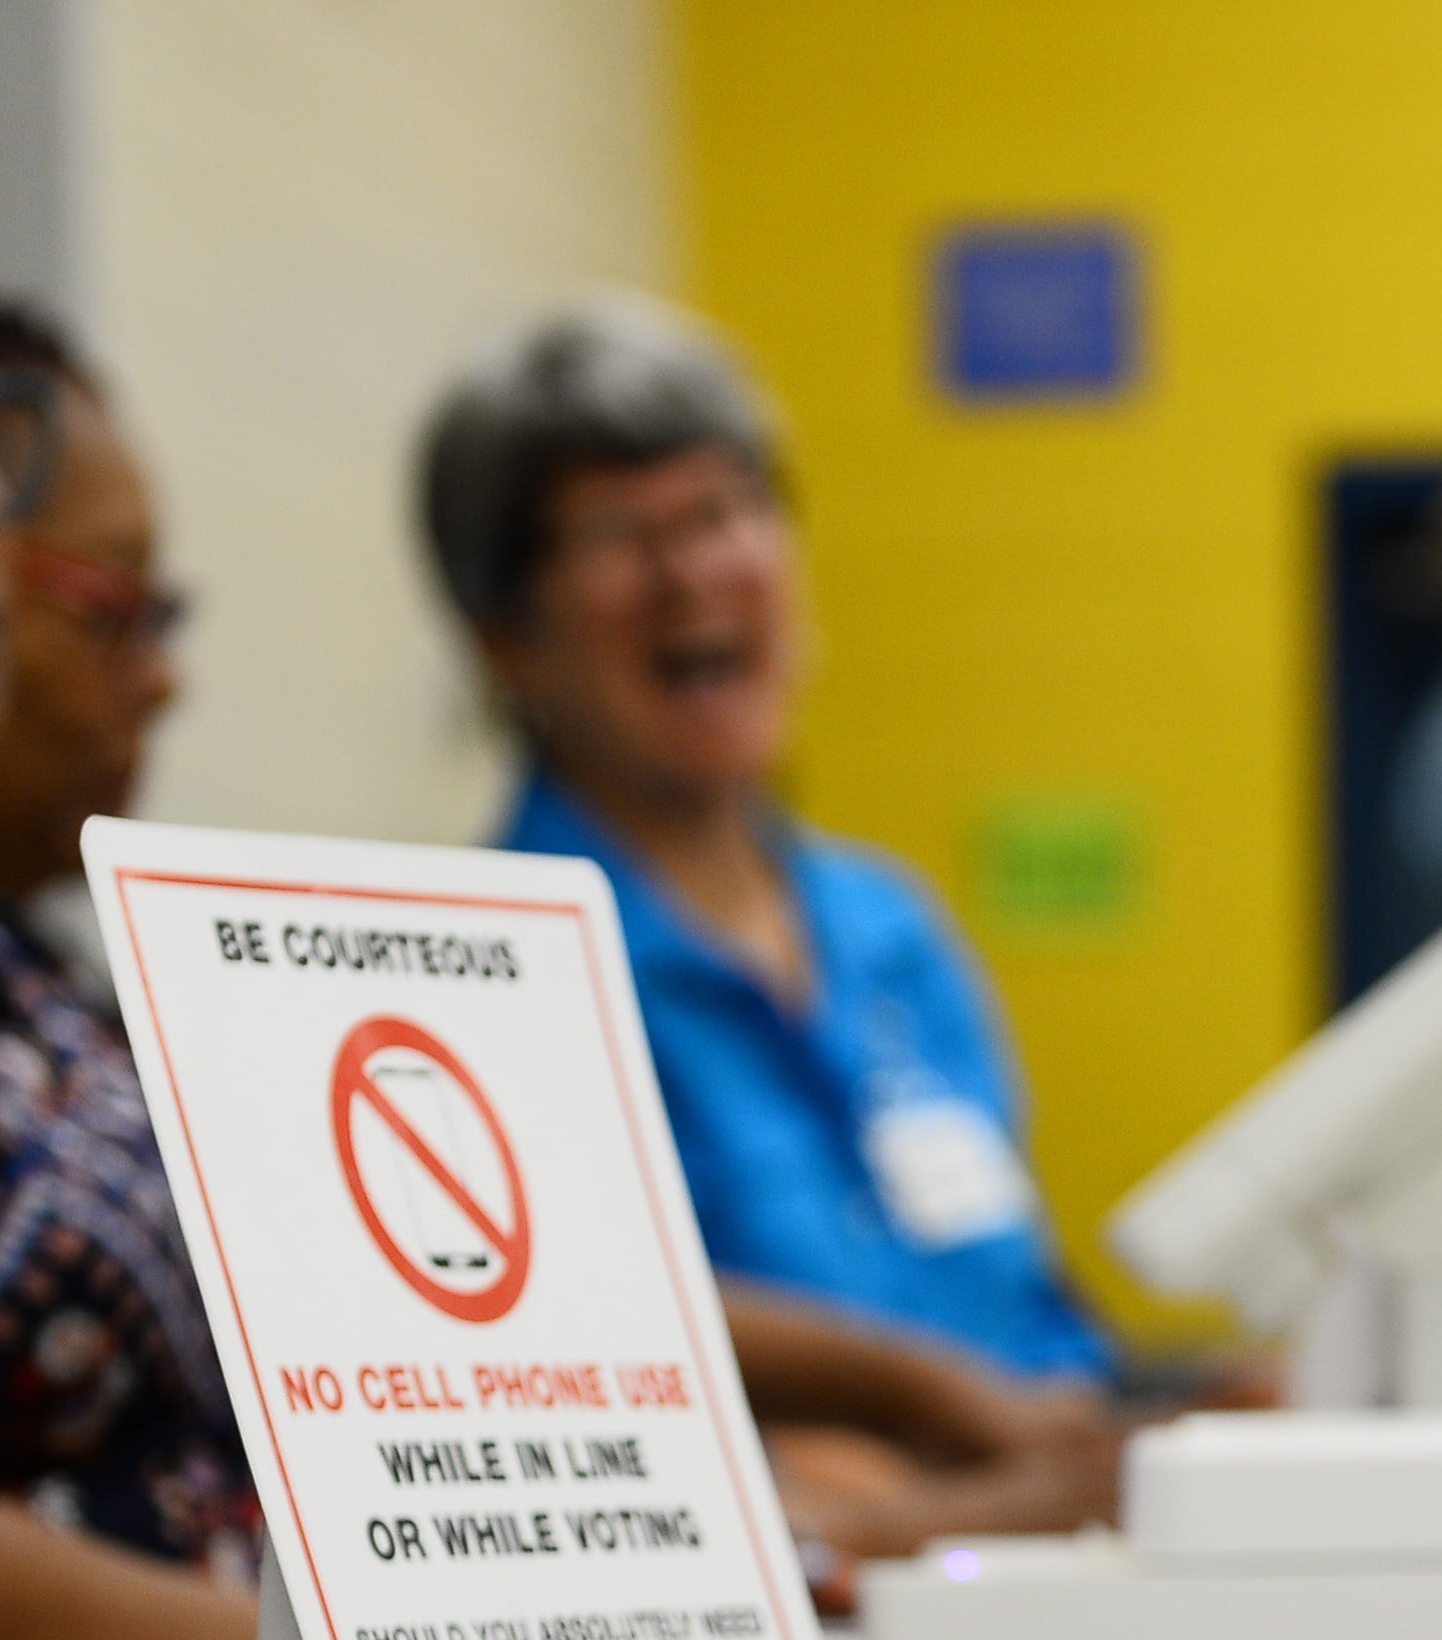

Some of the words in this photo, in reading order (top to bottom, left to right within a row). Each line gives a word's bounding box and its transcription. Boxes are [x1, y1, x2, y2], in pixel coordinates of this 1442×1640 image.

[215, 919, 271, 965] BE
[282, 923, 519, 981] COURTEOUS
[280, 1366, 344, 1413] NO
[357, 1365, 465, 1413] CELL
[472, 1364, 611, 1410] PHONE
[616, 1363, 693, 1410] USE
[378, 1440, 507, 1485] WHILE
[514, 1441, 557, 1480] IN
[564, 1437, 648, 1480] LINE
[367, 1517, 427, 1562] OR
[433, 1512, 560, 1557] WHILE
[565, 1508, 701, 1552] VOTING
[698, 1606, 765, 1640] NEED
